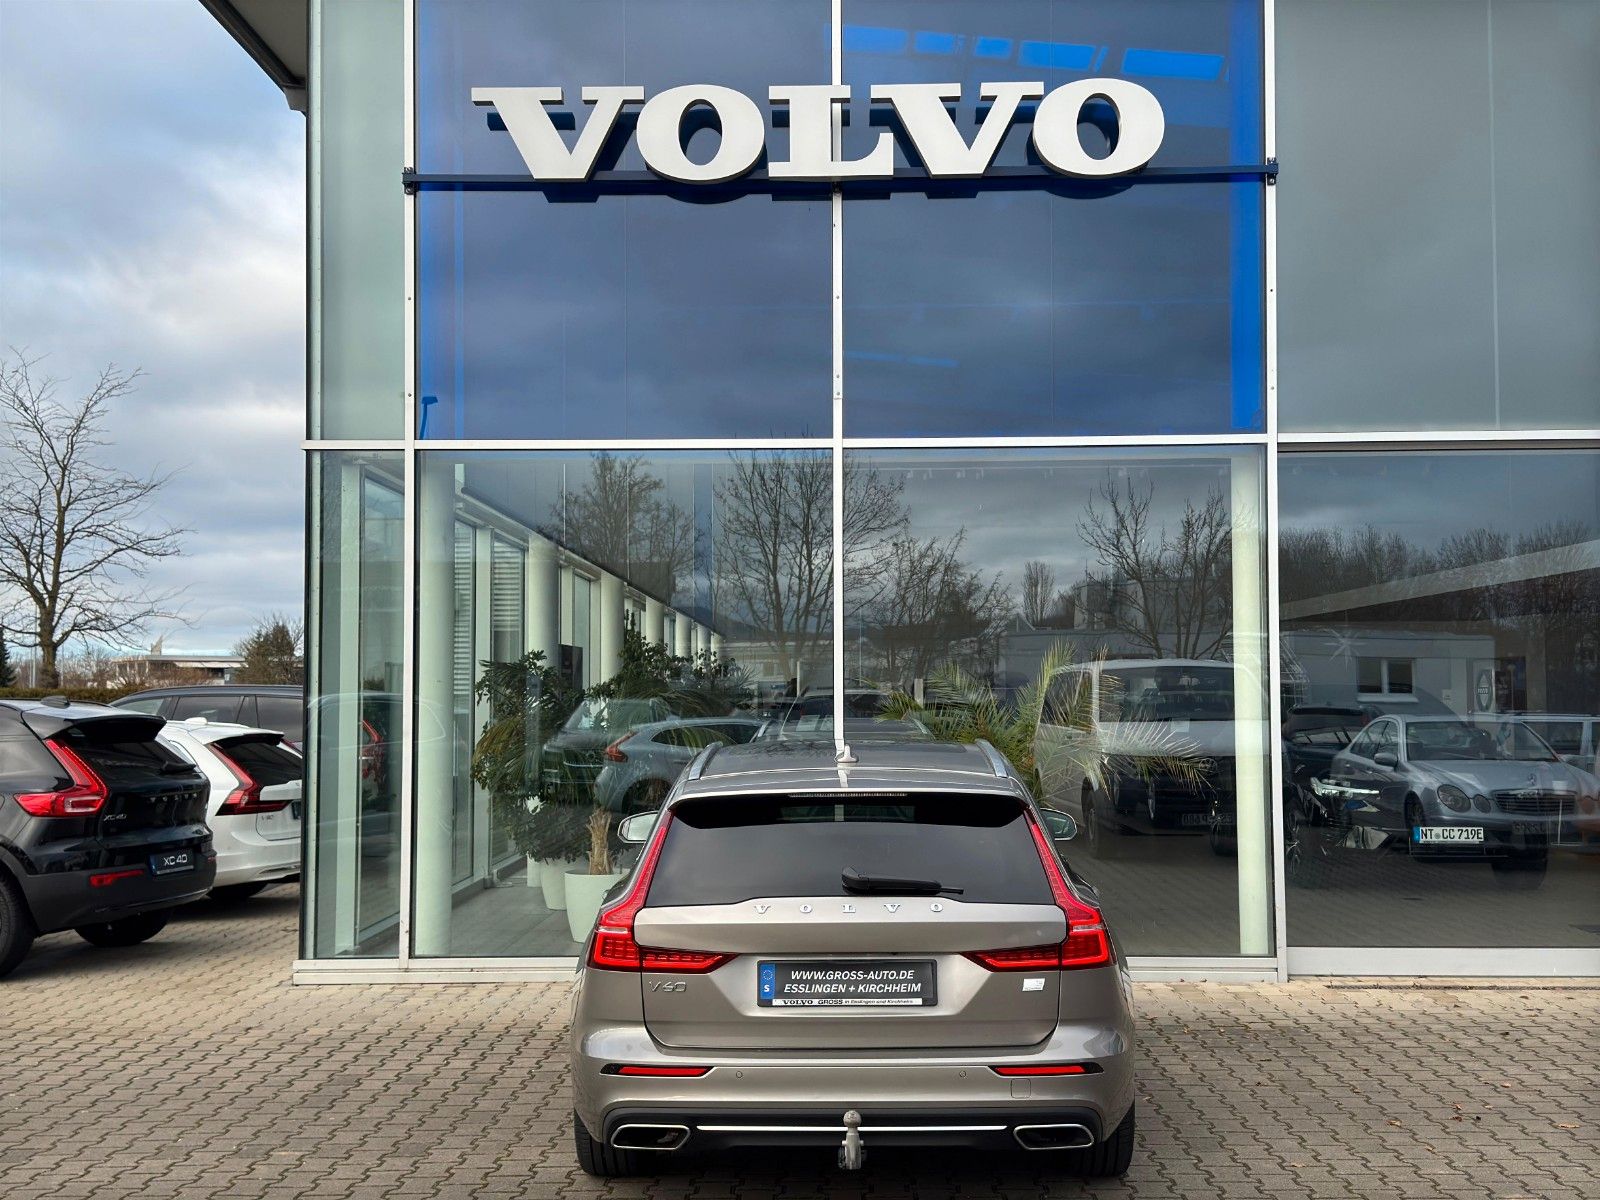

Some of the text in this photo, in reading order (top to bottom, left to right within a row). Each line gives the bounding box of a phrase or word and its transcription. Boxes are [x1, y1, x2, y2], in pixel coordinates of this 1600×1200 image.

[471, 77, 1165, 183] VOLVO
[1421, 828, 1483, 840] NT CC 719E
[754, 903, 944, 914] VOLVO
[791, 970, 915, 980] WWW.GROSS-AUTO.DE
[649, 981, 687, 992] V60
[784, 984, 846, 993] ESSLINGEN
[858, 983, 922, 993] KIRCHHEIM
